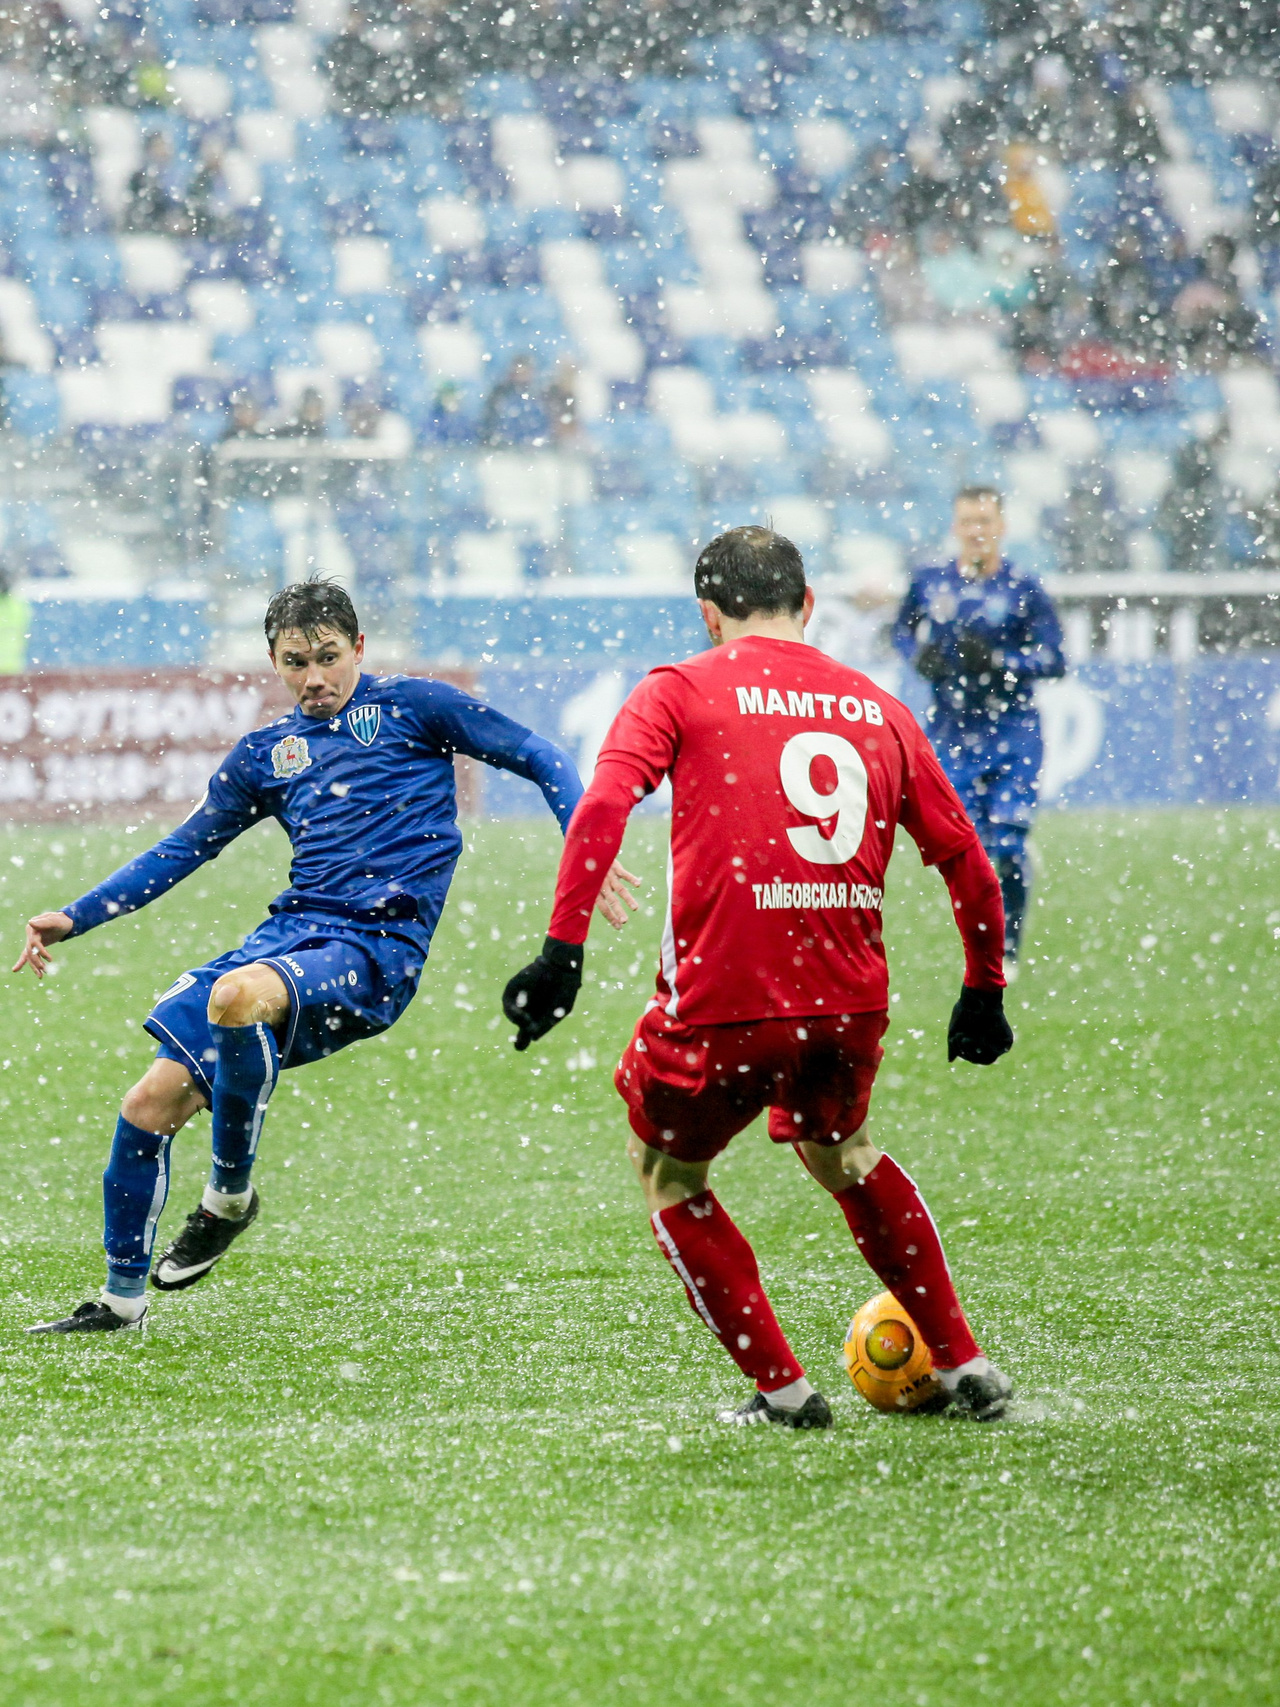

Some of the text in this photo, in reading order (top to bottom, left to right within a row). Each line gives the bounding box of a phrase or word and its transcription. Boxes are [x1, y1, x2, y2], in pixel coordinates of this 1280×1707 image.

[735, 687, 884, 726] МАМТОВ
[779, 731, 868, 865] 9
[752, 882, 847, 909] ТАМБОВСКАЯ
